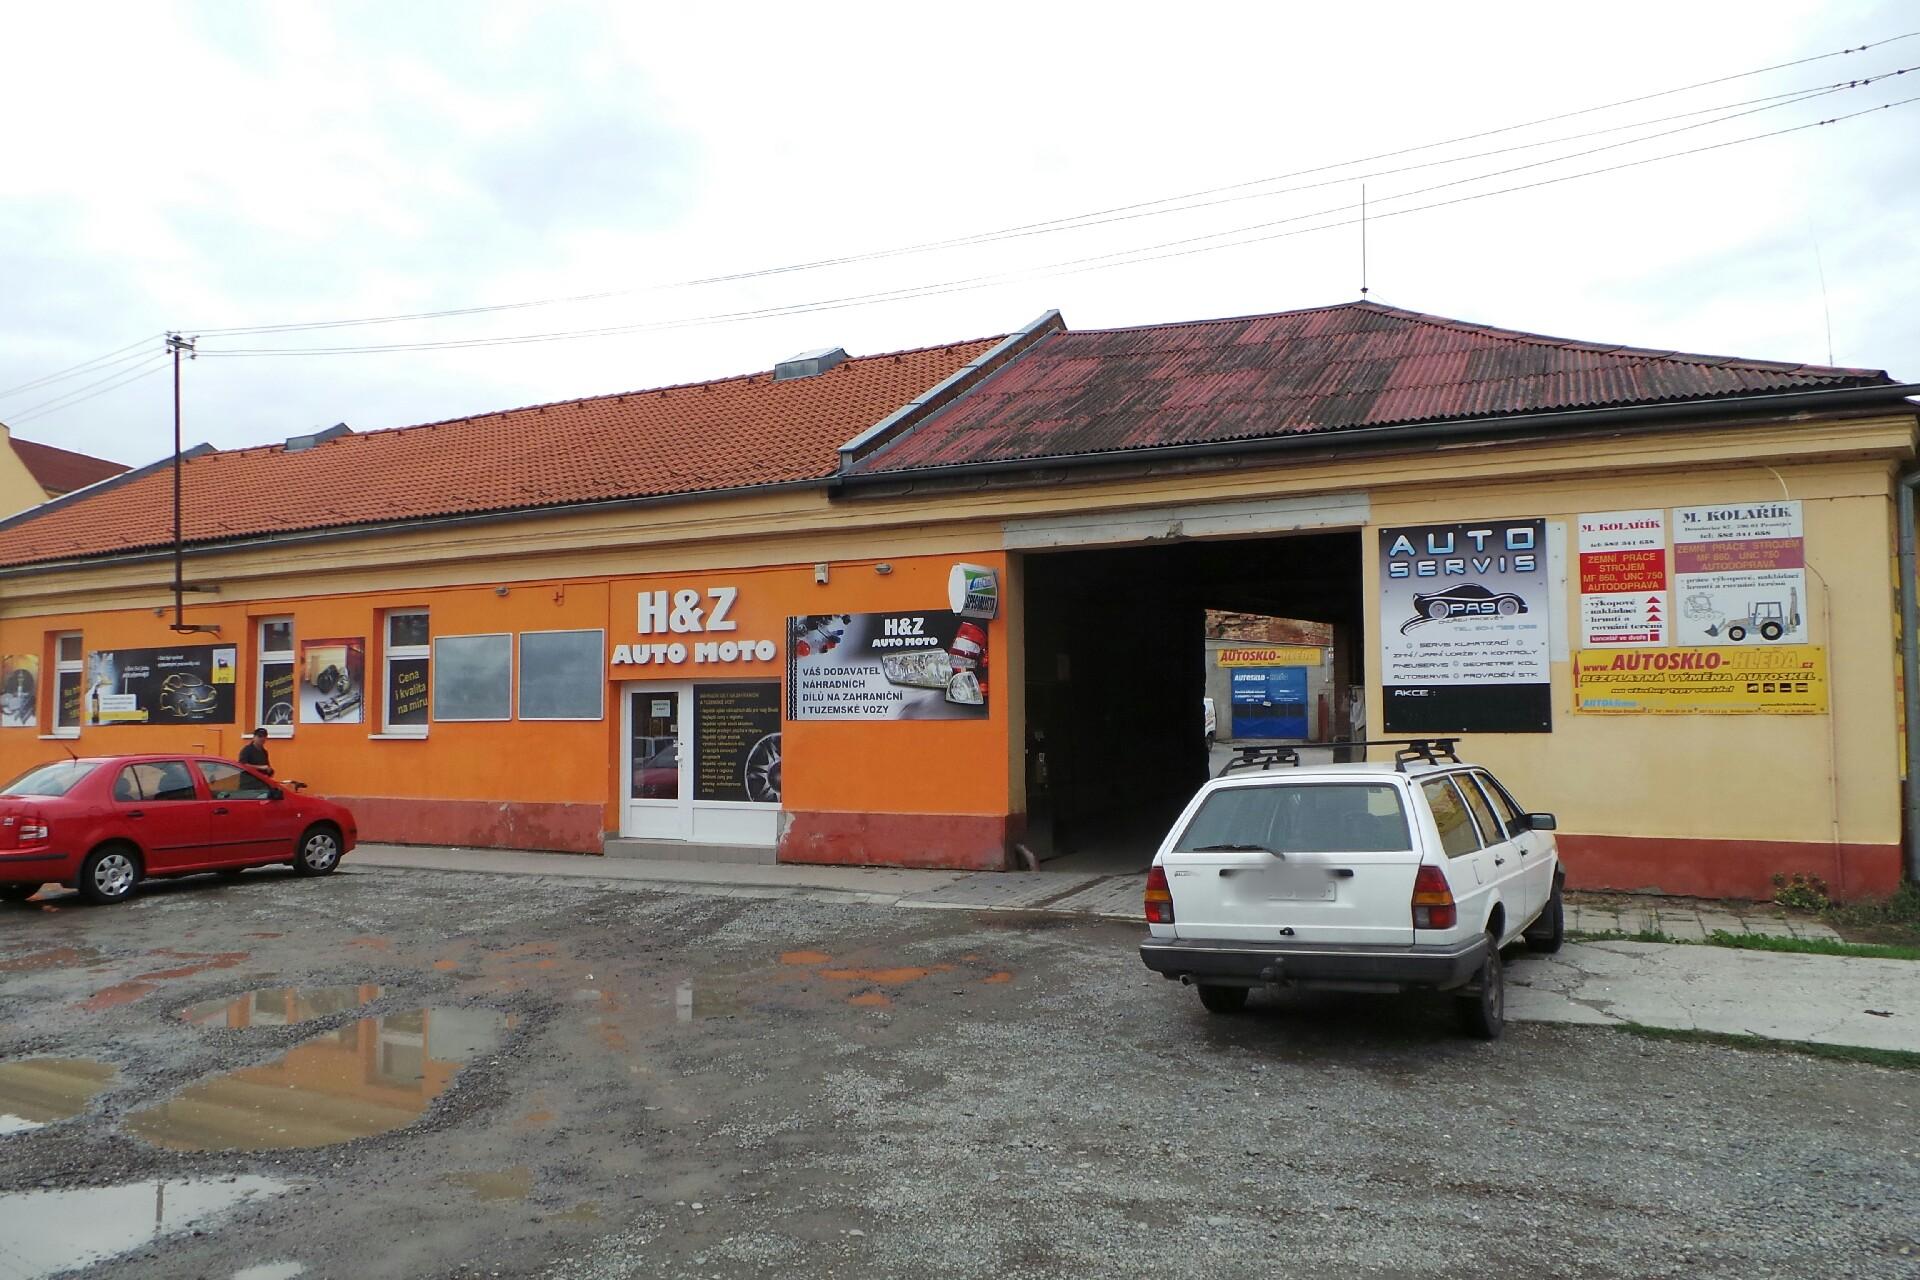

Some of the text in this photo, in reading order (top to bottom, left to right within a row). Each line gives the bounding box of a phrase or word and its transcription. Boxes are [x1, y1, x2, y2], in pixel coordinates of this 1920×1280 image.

[1682, 504, 1792, 523] M. KOLAŘÍK
[1600, 519, 1660, 531] KOLAŘÍK
[1389, 527, 1535, 557] AUTO
[1678, 539, 1800, 554] ZEMNÍ PRÁCE STROJEM
[1588, 552, 1656, 564] ZEMNÍ PRÁCE
[1696, 552, 1709, 562] MF
[1389, 555, 1536, 578] SERVIS
[1599, 563, 1645, 573] STROJEM
[1702, 560, 1777, 571] AUTODOPRAVA
[1583, 574, 1597, 583] MF
[1623, 572, 1643, 581] UNC
[1647, 571, 1663, 580] 750
[1587, 580, 1659, 592] AUTODOPRAVA
[637, 586, 738, 634] H&Z
[884, 617, 925, 636] H&Z
[871, 636, 938, 648] AUTO MOTO
[611, 640, 777, 665] AUTO MOTO
[398, 670, 420, 684] Cena
[802, 667, 881, 677] VÁŠ DODAVATEL
[1581, 671, 1816, 682] BEZPLATNÁ VÝMĚNA AUTOSKEL
[802, 680, 866, 689] NÁHRADNÍCH
[399, 683, 426, 699] kvalita
[802, 690, 903, 702] DÍLŮ NA ZAHRANIČNÍ
[1394, 689, 1429, 697] AKCE
[398, 705, 409, 715] na
[808, 705, 860, 715] TUZEMSKÉ
[862, 705, 889, 715] VOZY
